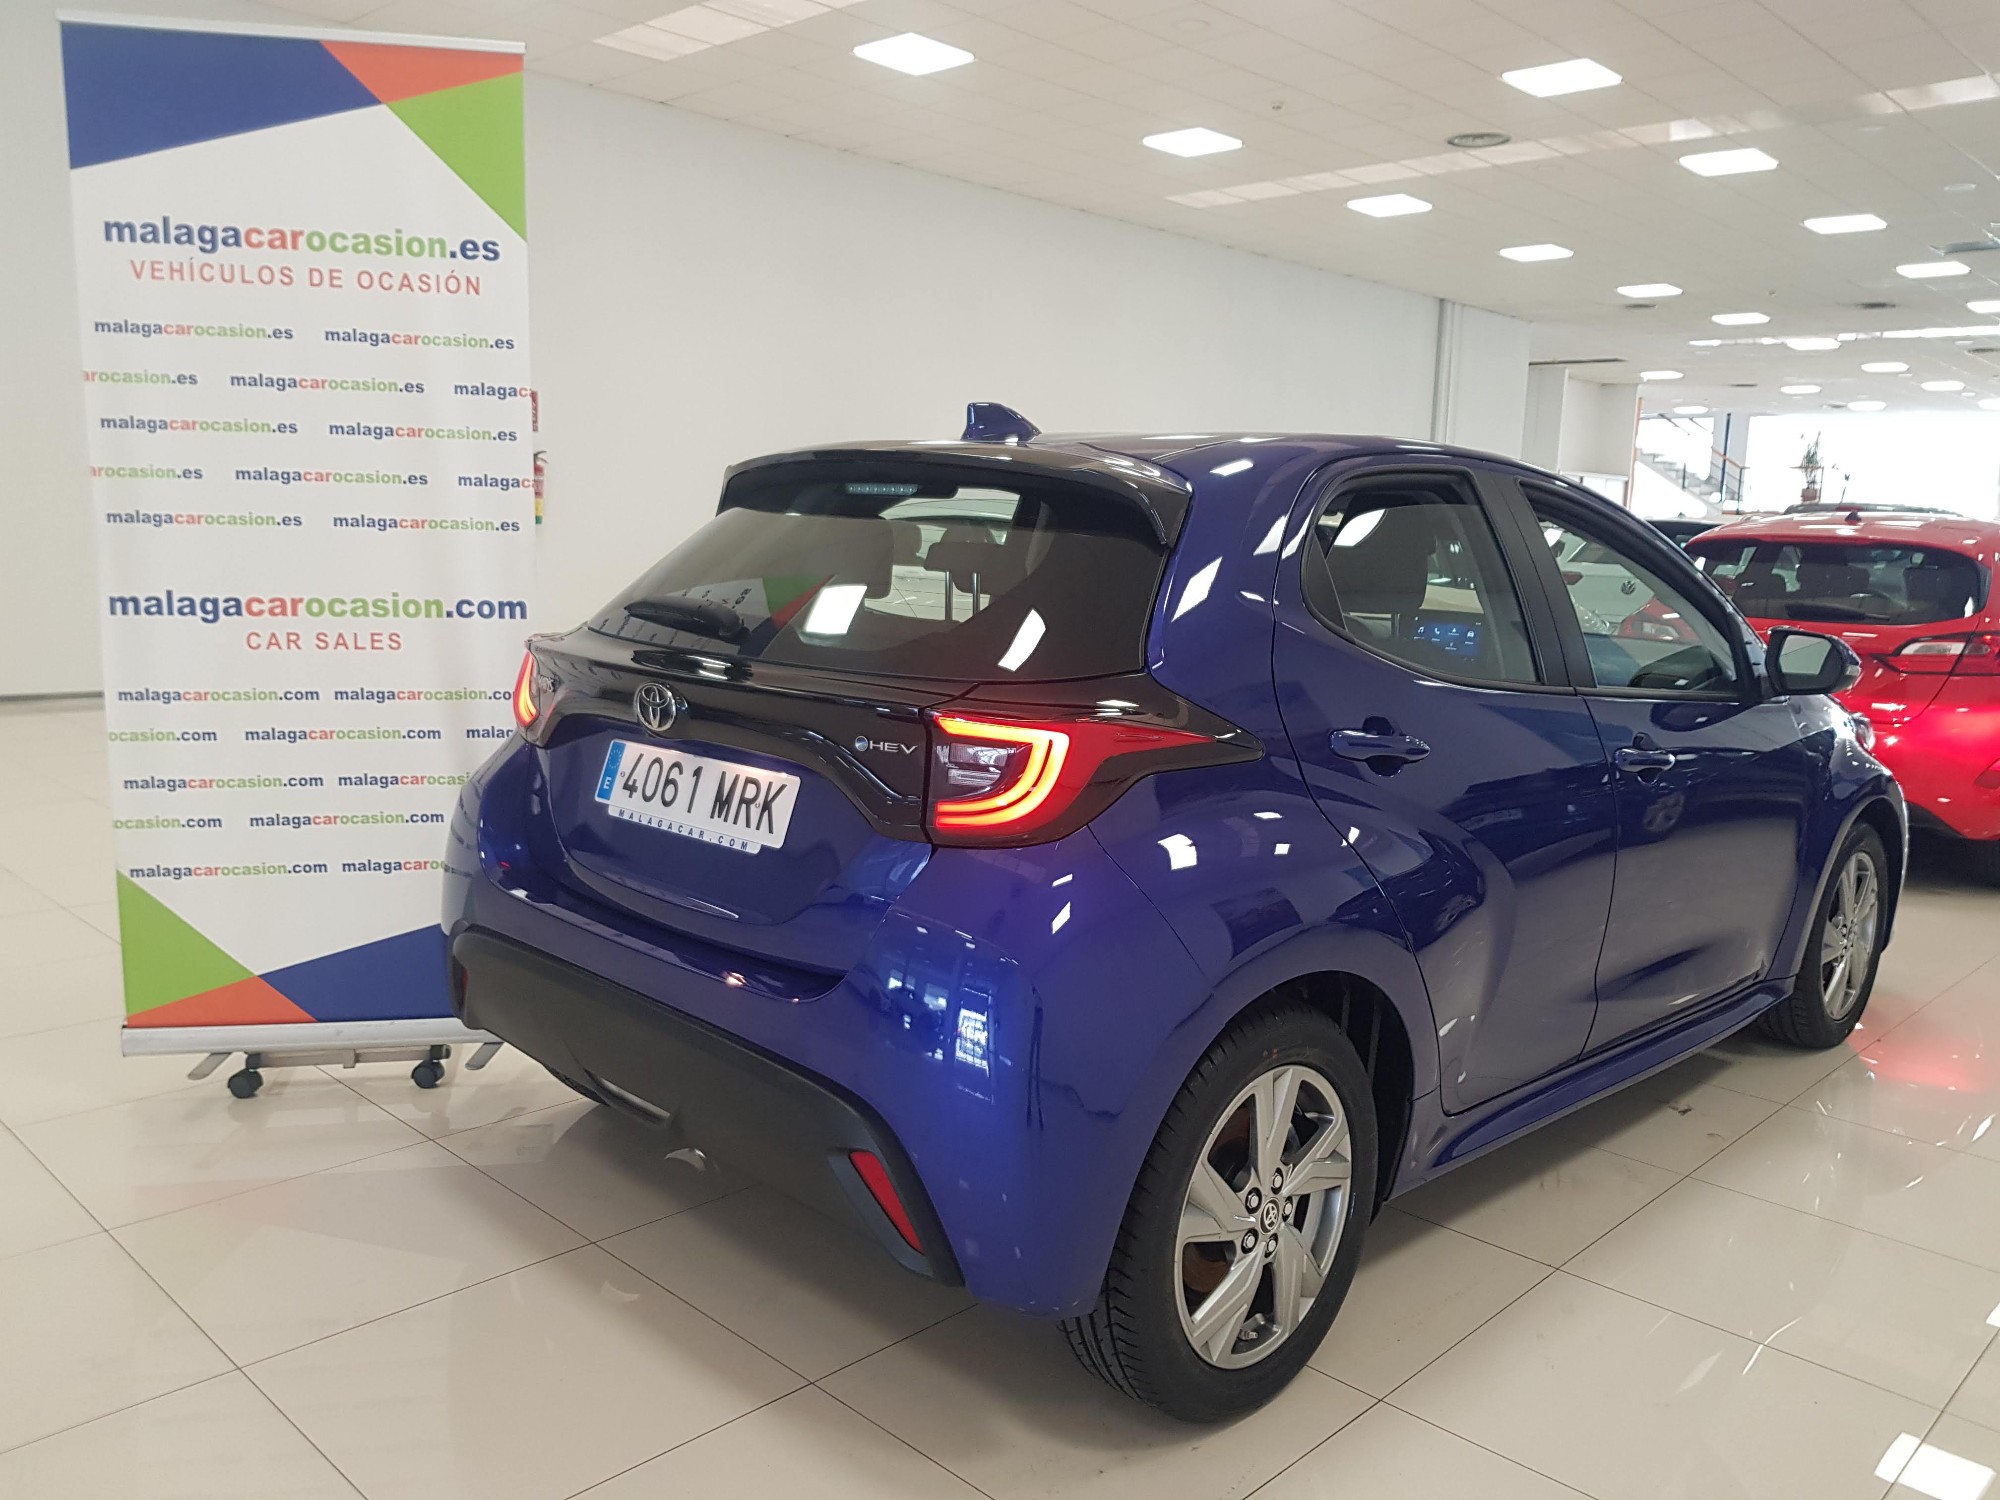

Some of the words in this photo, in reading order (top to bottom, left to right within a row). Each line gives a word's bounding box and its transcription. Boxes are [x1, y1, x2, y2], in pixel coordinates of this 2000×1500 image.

[104, 216, 500, 262] malagacarocasion.es
[130, 256, 295, 287] VEHÍCULOS
[309, 268, 343, 288] DE
[357, 270, 481, 295] OCASIÓN
[94, 319, 293, 340] malagacarocasion.es
[325, 327, 514, 350] malagacarocasion.es
[230, 373, 424, 394] malagacarocasion.es
[100, 414, 298, 434] malagacarocasion.es
[329, 421, 517, 442] malagacarocasion.es
[235, 466, 428, 485] malagacarocasion.es
[106, 509, 302, 527] malagacarocasion.es
[333, 513, 520, 532] malagacarocasion.es
[109, 590, 527, 623] malagacarocasion.com
[246, 632, 302, 650] CAR
[315, 632, 402, 650] SALES
[118, 687, 320, 704] malagacarocasion.com
[334, 686, 514, 704] malagacarocasion.co
[245, 726, 441, 743] malagacarocasion.com
[868, 741, 917, 754] HEV
[123, 774, 324, 791] malagacarocasion.com
[603, 777, 611, 789] E
[622, 753, 704, 813] 4061
[710, 771, 787, 834] MRK
[249, 812, 444, 829] malagacarocasion.com
[618, 809, 748, 850] MALAGACAR.COM
[130, 861, 328, 879] malagacarocasion.com
